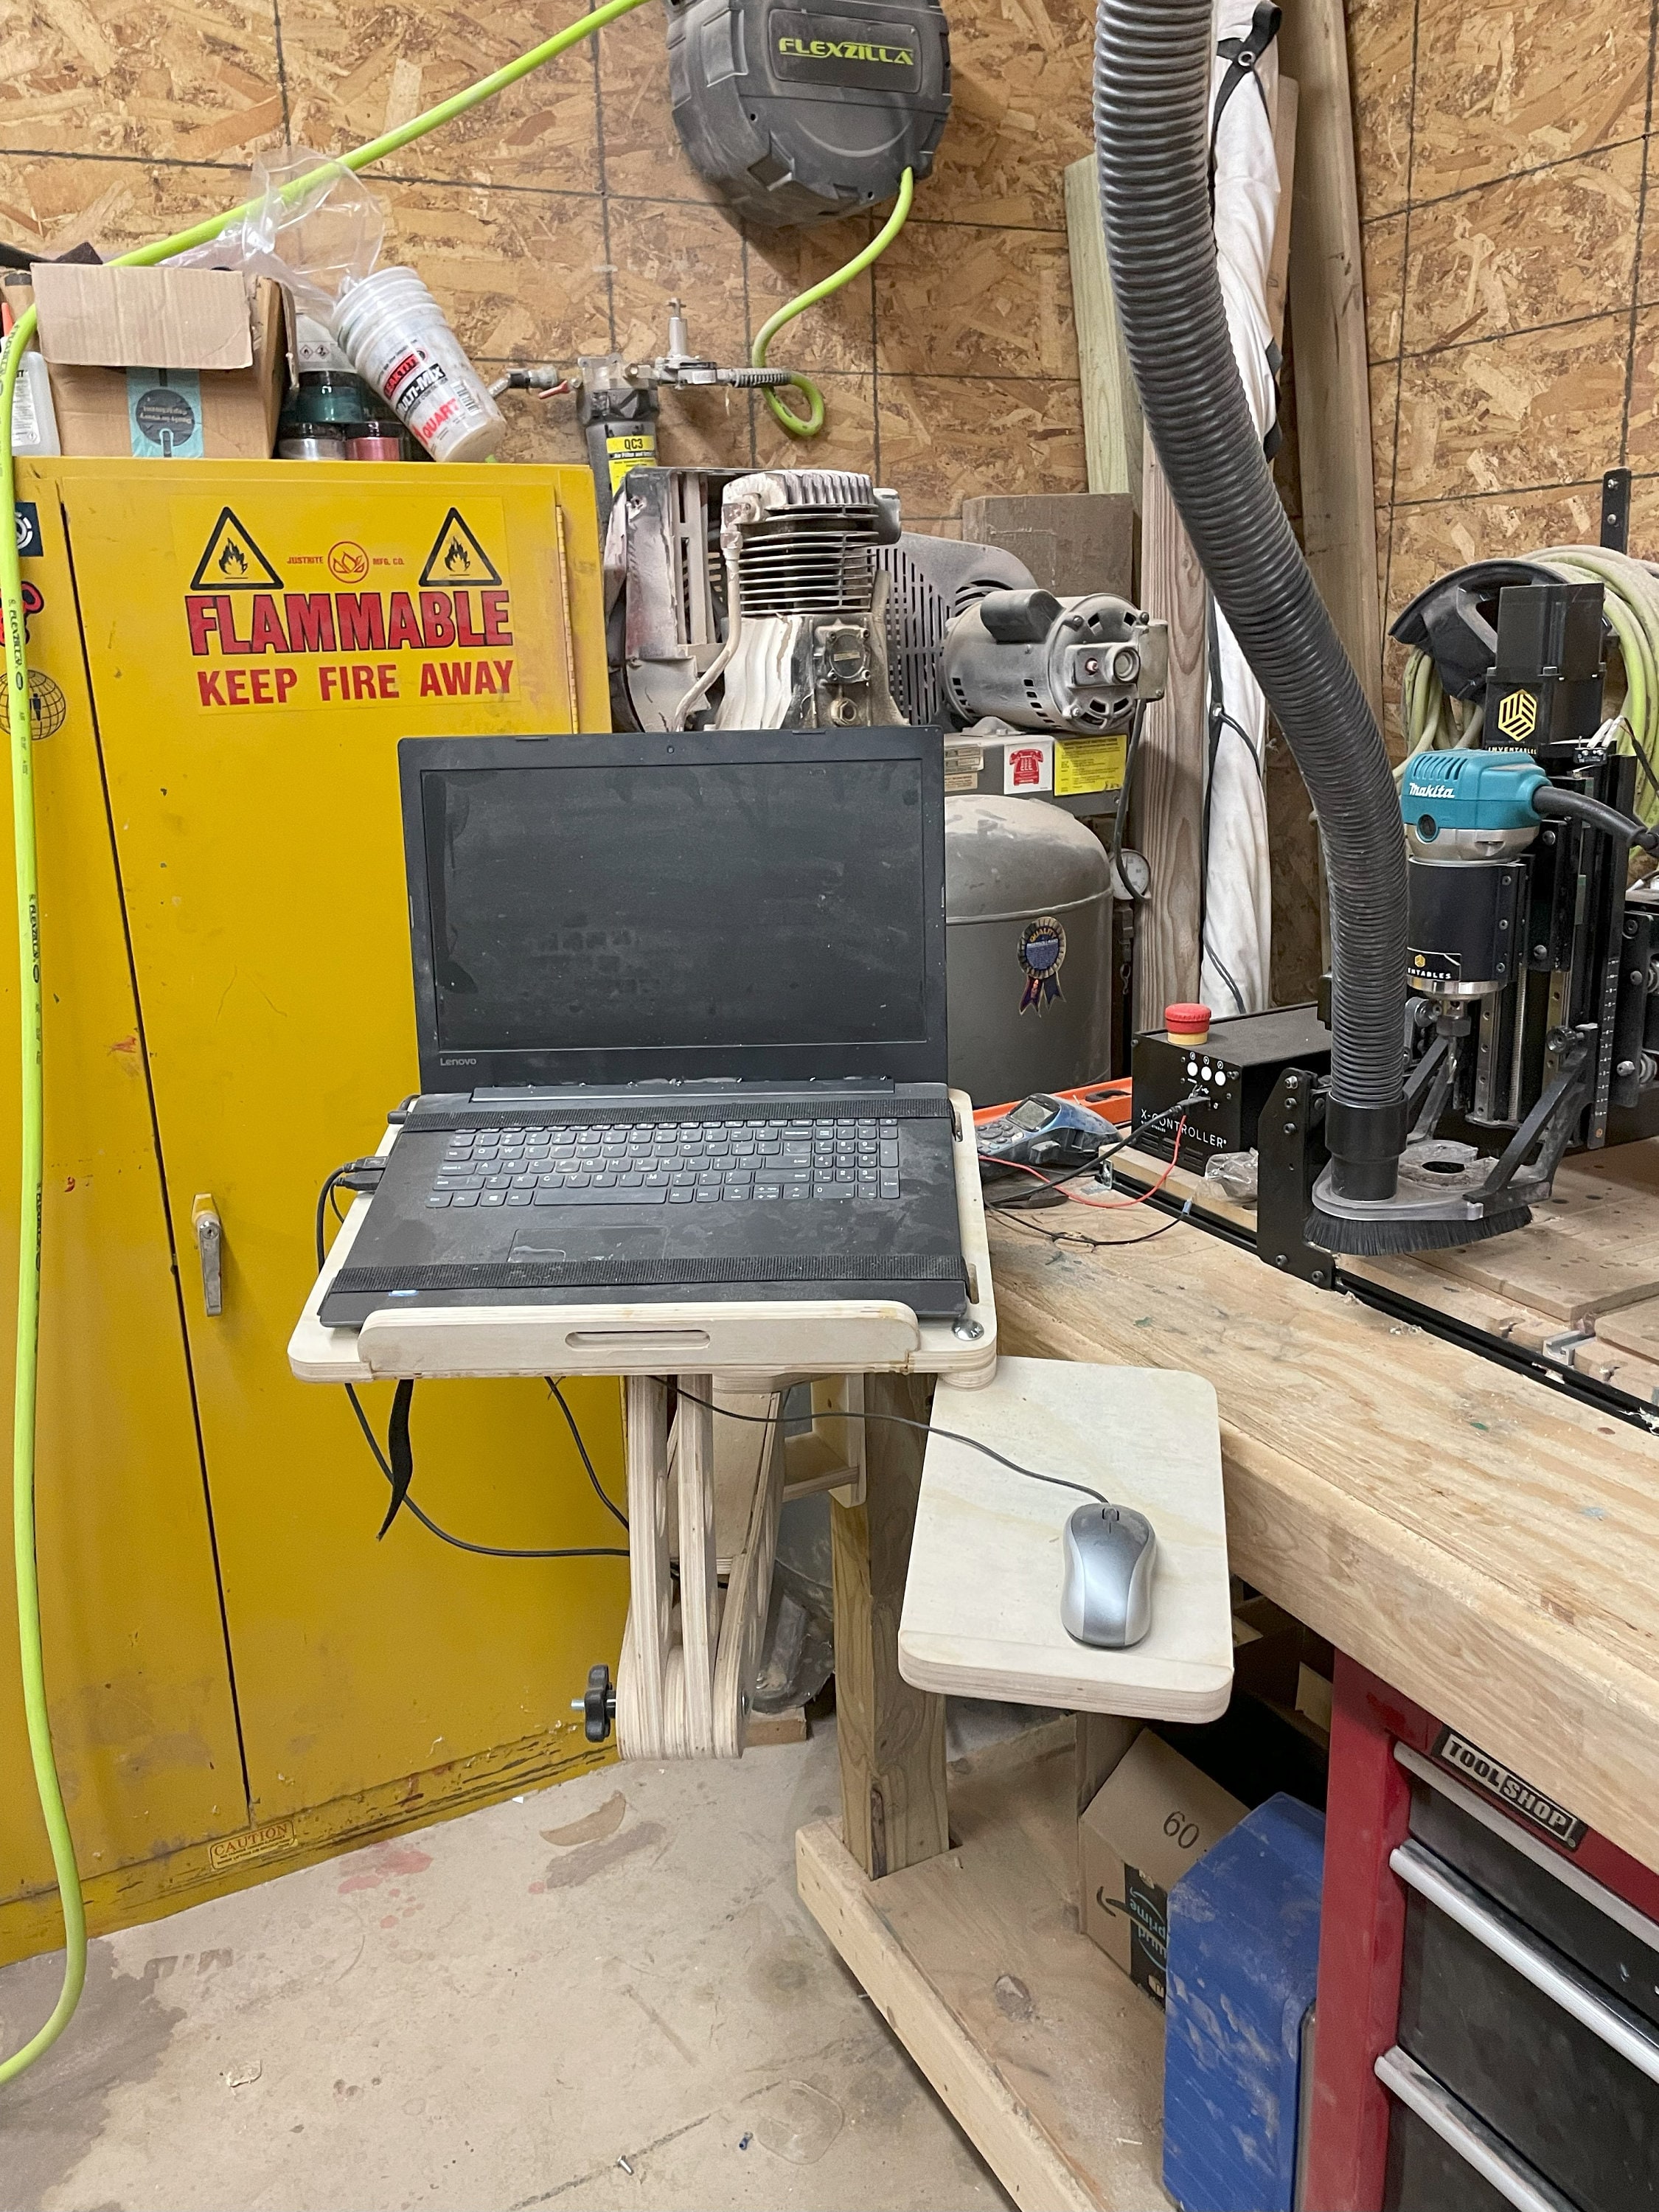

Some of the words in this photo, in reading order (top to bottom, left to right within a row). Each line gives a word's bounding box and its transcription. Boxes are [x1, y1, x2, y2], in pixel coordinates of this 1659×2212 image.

[779, 38, 914, 65] FLEXZILLA
[422, 397, 460, 439] QUART
[625, 438, 643, 451] QC3
[287, 556, 323, 564] JUSTRITE
[184, 590, 514, 656] FLAMMABLE
[198, 667, 298, 706] KEEP
[319, 664, 399, 701] FIRE
[420, 659, 514, 698] AWAY
[1029, 928, 1057, 943] QUALITY
[1408, 967, 1452, 979] ENTABLES
[439, 1057, 477, 1066] Lenovo
[1449, 1739, 1500, 1788] TOOL
[1503, 1779, 1567, 1827] SHOP
[214, 1823, 288, 1857] CAUTION
[1163, 1810, 1200, 1849] 60
[1130, 1898, 1166, 1941] prime
